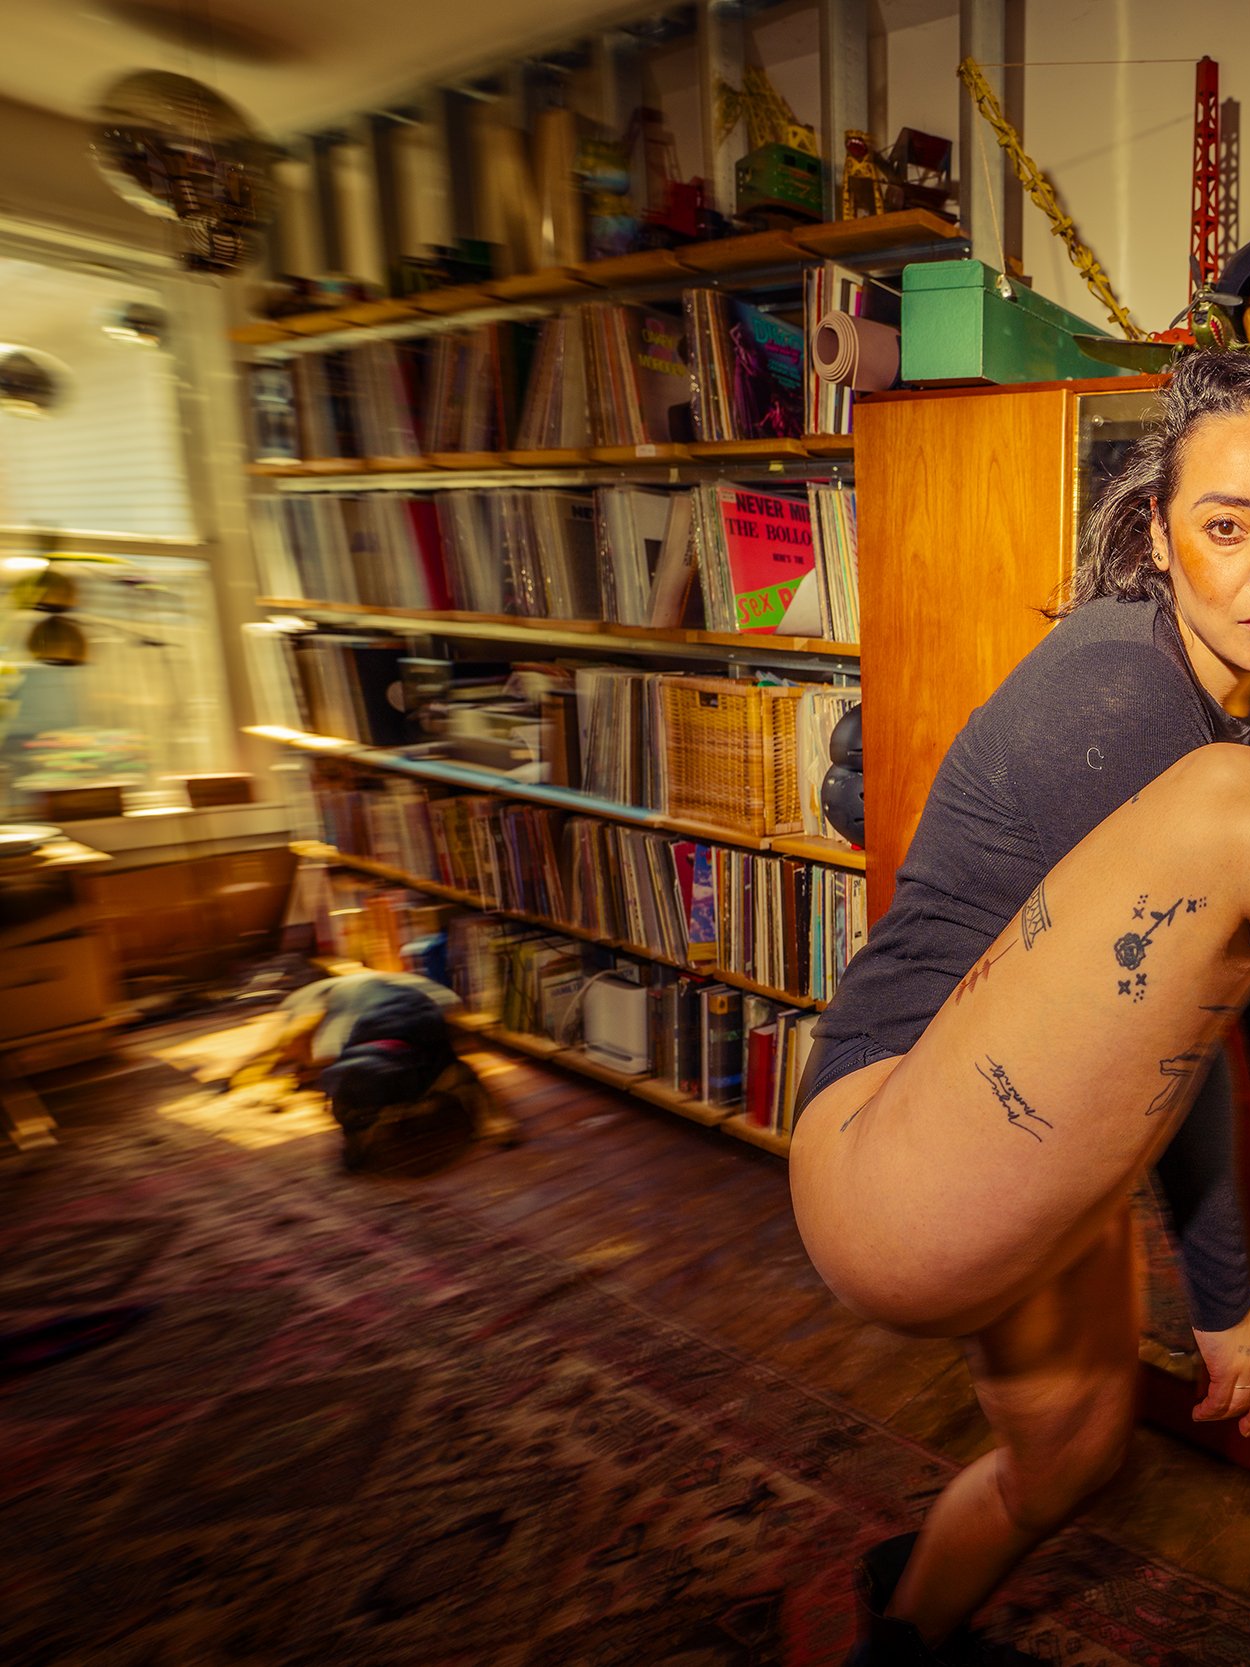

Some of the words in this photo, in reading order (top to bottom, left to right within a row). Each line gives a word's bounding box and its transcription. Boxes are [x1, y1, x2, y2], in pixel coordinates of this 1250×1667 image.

[735, 493, 785, 518] NEVER
[725, 517, 759, 538] THE
[765, 523, 812, 546] BOLLO
